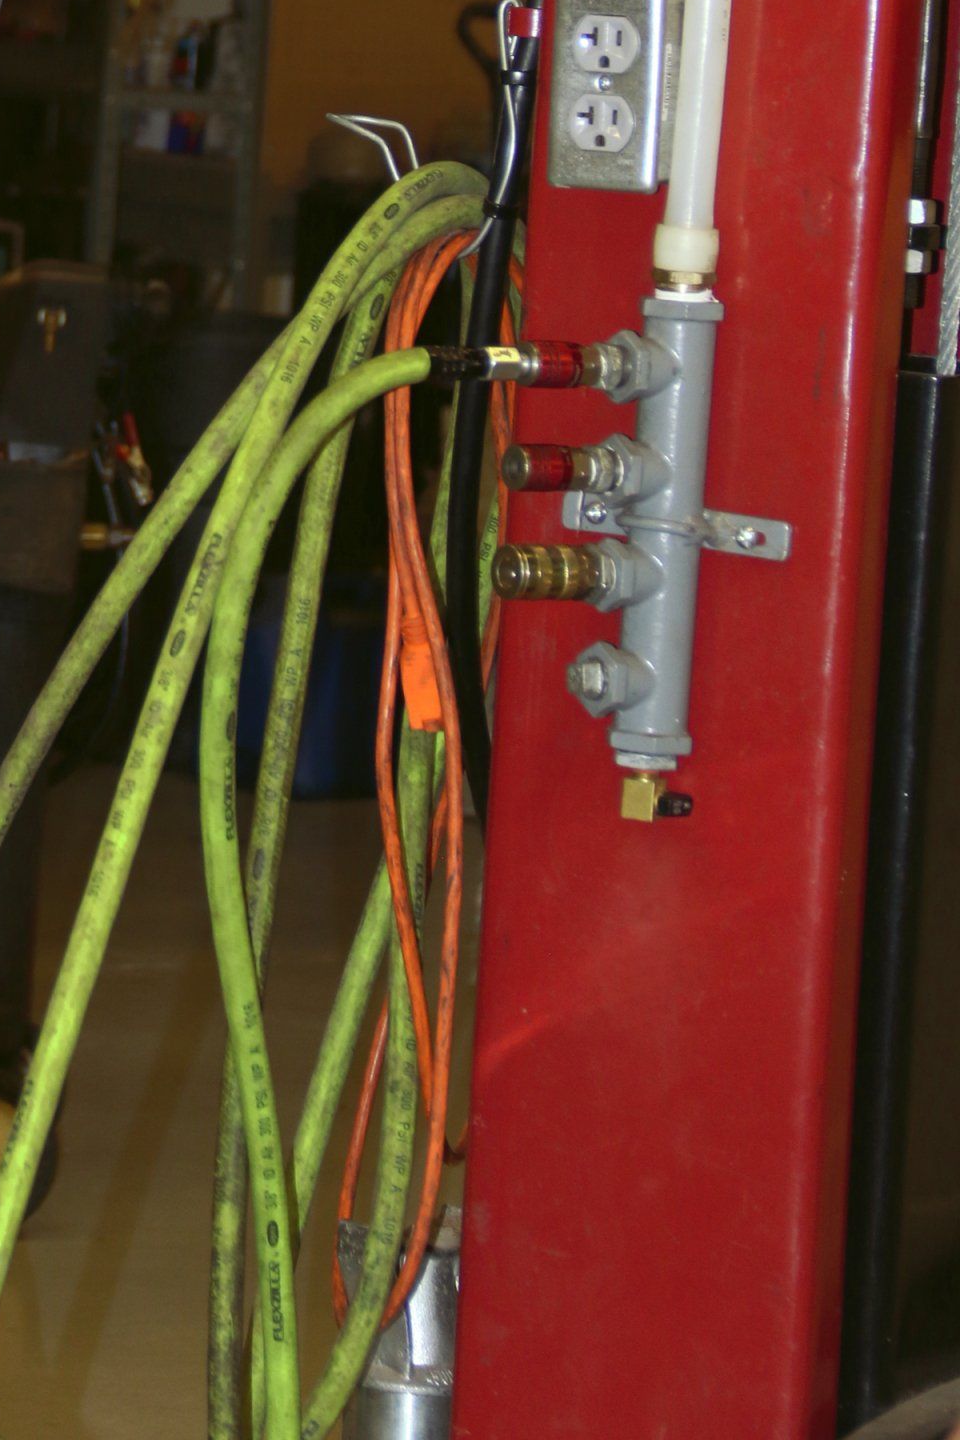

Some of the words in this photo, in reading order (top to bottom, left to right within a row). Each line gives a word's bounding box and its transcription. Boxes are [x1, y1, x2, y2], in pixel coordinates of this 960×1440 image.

[332, 270, 345, 288] 300
[319, 291, 335, 309] PSI
[308, 314, 324, 332] WP
[299, 335, 312, 345] A
[480, 542, 492, 561] PSI
[290, 647, 302, 657] A
[296, 598, 311, 624] 1016
[397, 1121, 411, 1143] PSI
[395, 1153, 406, 1176] WP
[391, 1184, 401, 1193] A
[268, 1261, 285, 1342] FLEXZILLA
